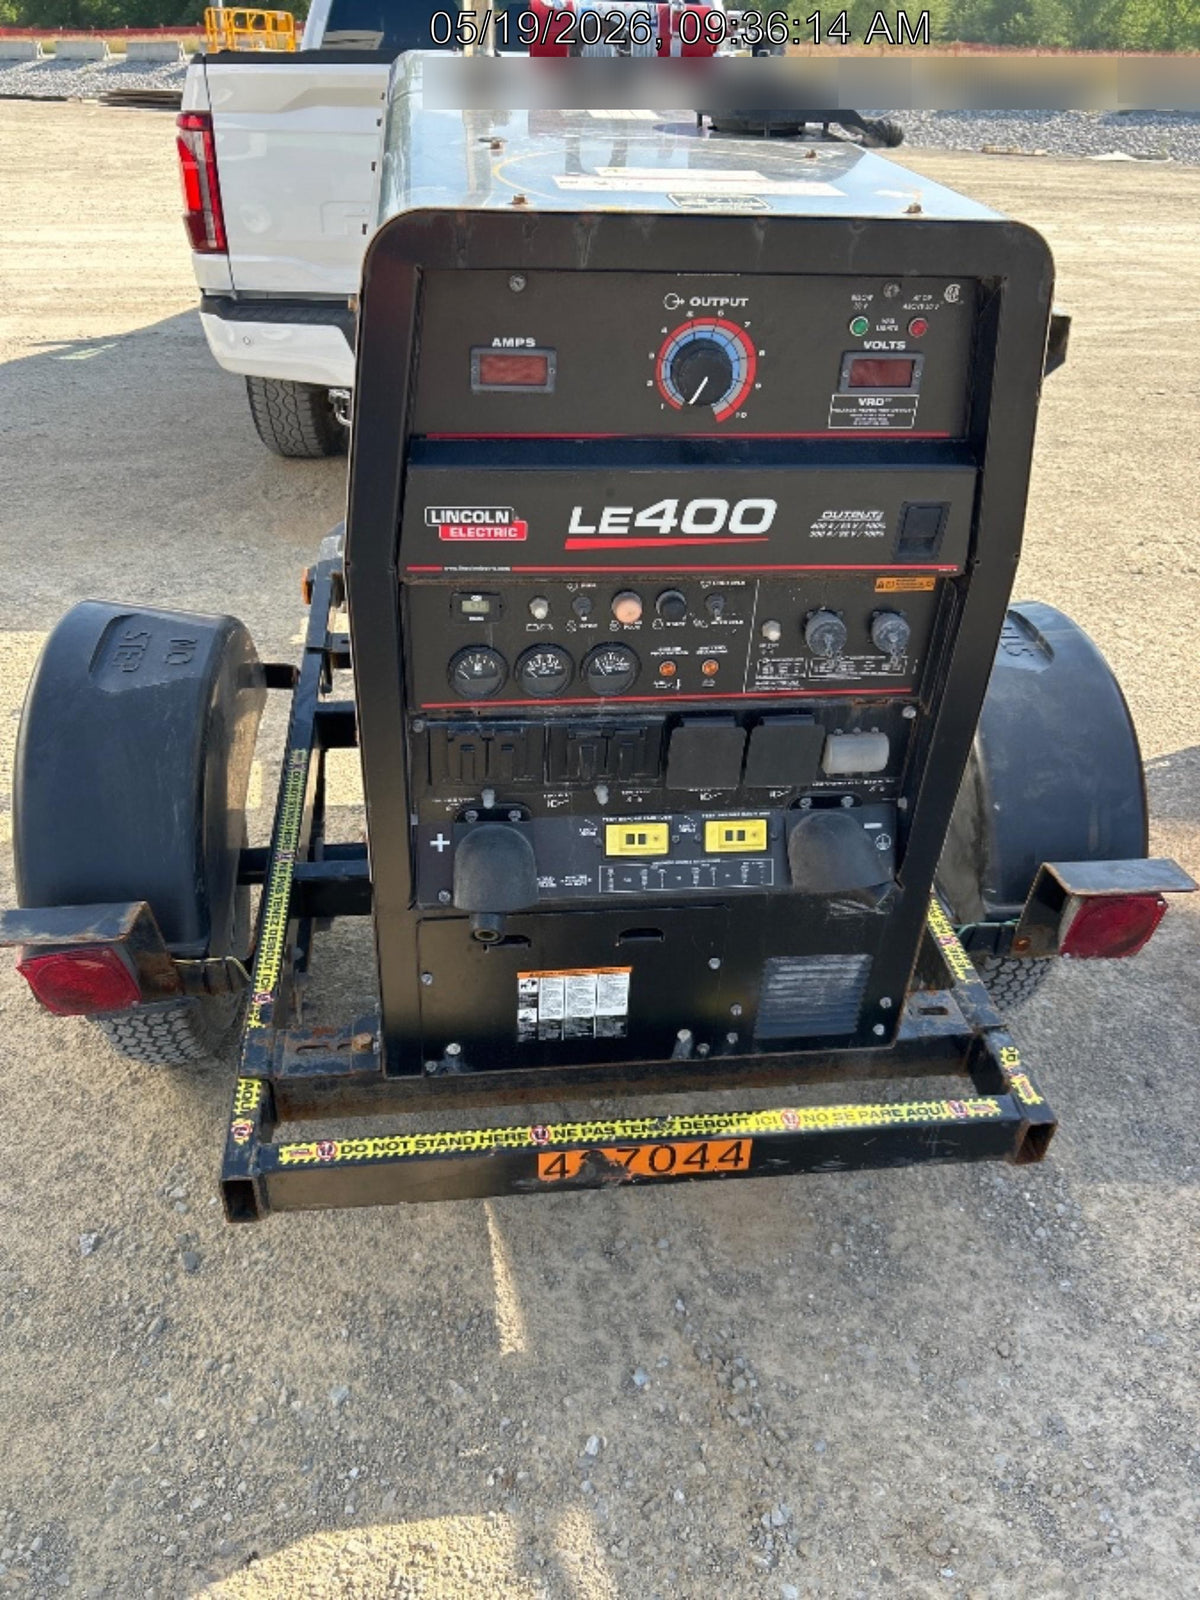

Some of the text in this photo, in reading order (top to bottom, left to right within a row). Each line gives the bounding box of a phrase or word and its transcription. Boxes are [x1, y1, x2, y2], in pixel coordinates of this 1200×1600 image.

[689, 296, 749, 307] OUTPUT
[491, 337, 536, 347] AMPS
[863, 341, 906, 350] VOLTS
[430, 509, 509, 524] LINCOLN
[568, 498, 778, 534] LE400
[450, 527, 518, 538] ELECTRIC
[263, 930, 279, 972] DEBOUT
[803, 1112, 829, 1122] NO
[833, 1111, 856, 1121] SE
[859, 1109, 904, 1119] PARE
[554, 1115, 778, 1139] NE PAS TENZ DEBOUT ICI
[340, 1131, 528, 1155] DO NOT STAND HERE
[543, 1140, 745, 1179] 47044
